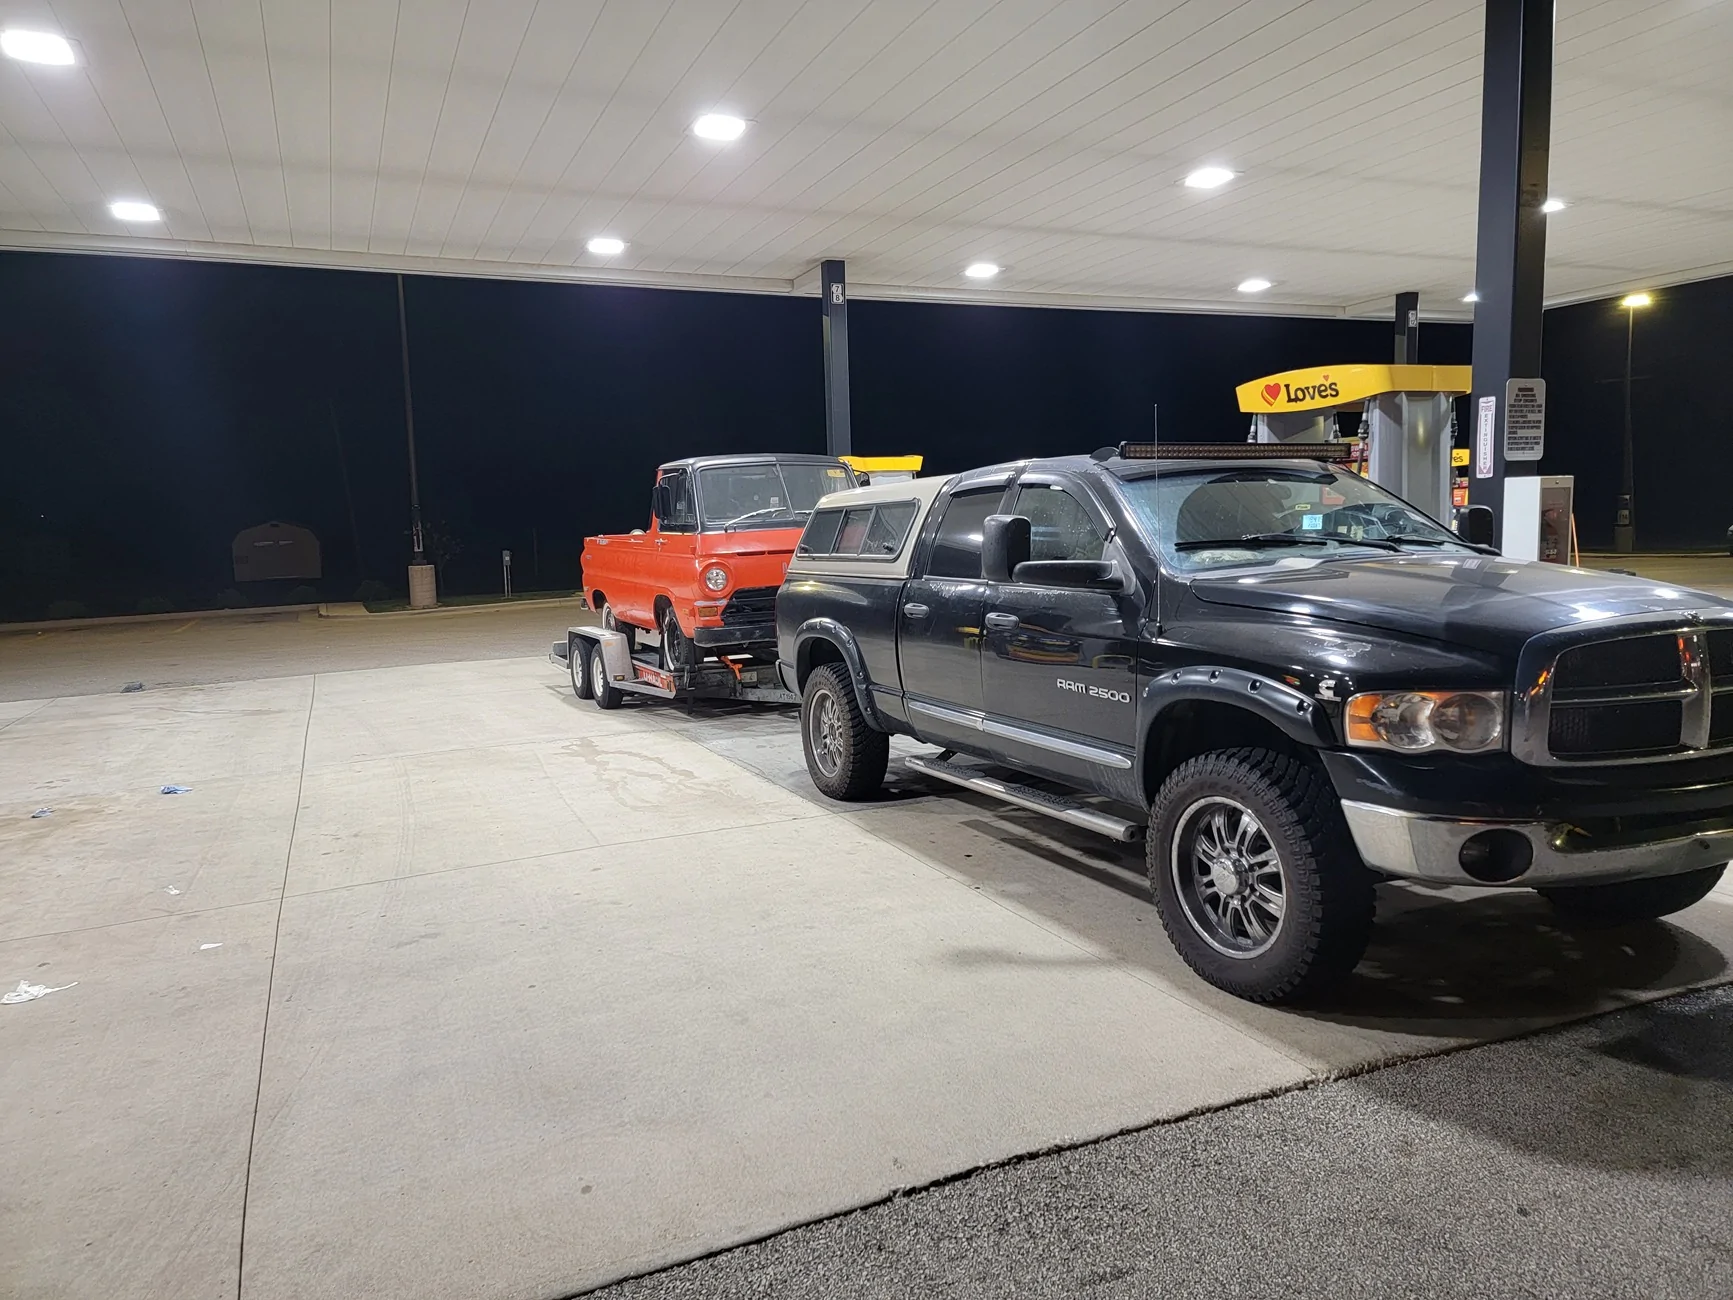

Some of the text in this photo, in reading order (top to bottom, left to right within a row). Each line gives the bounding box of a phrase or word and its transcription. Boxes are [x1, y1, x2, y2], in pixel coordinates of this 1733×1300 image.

[1481, 404, 1492, 412] FIRE
[1057, 678, 1131, 703] RAM 2500
